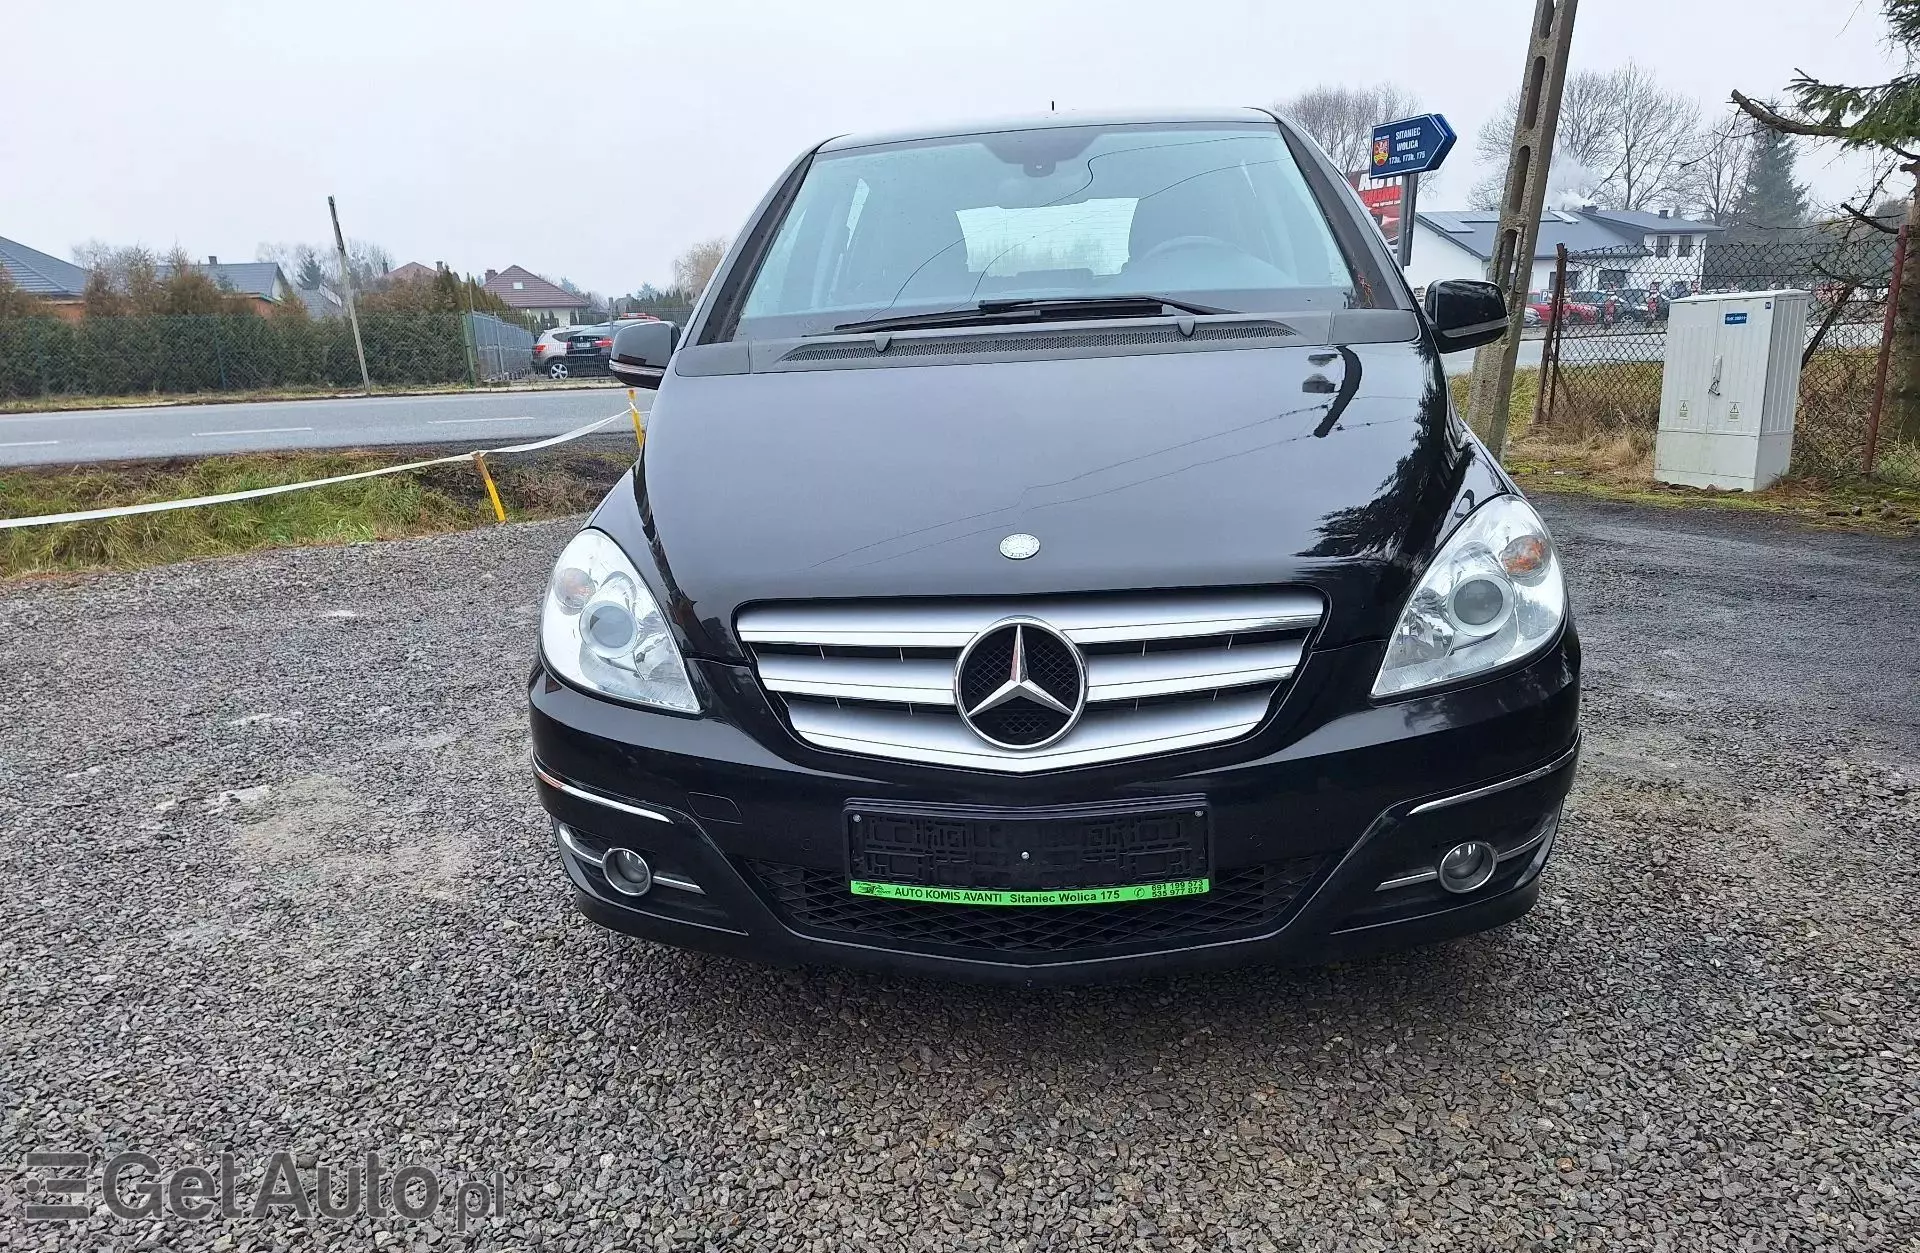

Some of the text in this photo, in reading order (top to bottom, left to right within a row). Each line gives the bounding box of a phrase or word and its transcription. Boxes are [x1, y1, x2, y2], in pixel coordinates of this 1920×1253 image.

[1395, 127, 1421, 140] SITANIEC
[1396, 140, 1419, 151] WOLICA
[1151, 884, 1167, 892] 691
[1169, 881, 1186, 889] 199
[894, 886, 923, 898] AUTO
[925, 888, 960, 901] KOMIS
[962, 891, 1002, 903] AVANTI
[1009, 892, 1056, 904] Sitaniec
[1058, 889, 1097, 903] Wolica
[1100, 890, 1121, 901] 175
[1152, 890, 1168, 898] 535
[1169, 888, 1187, 896] 977
